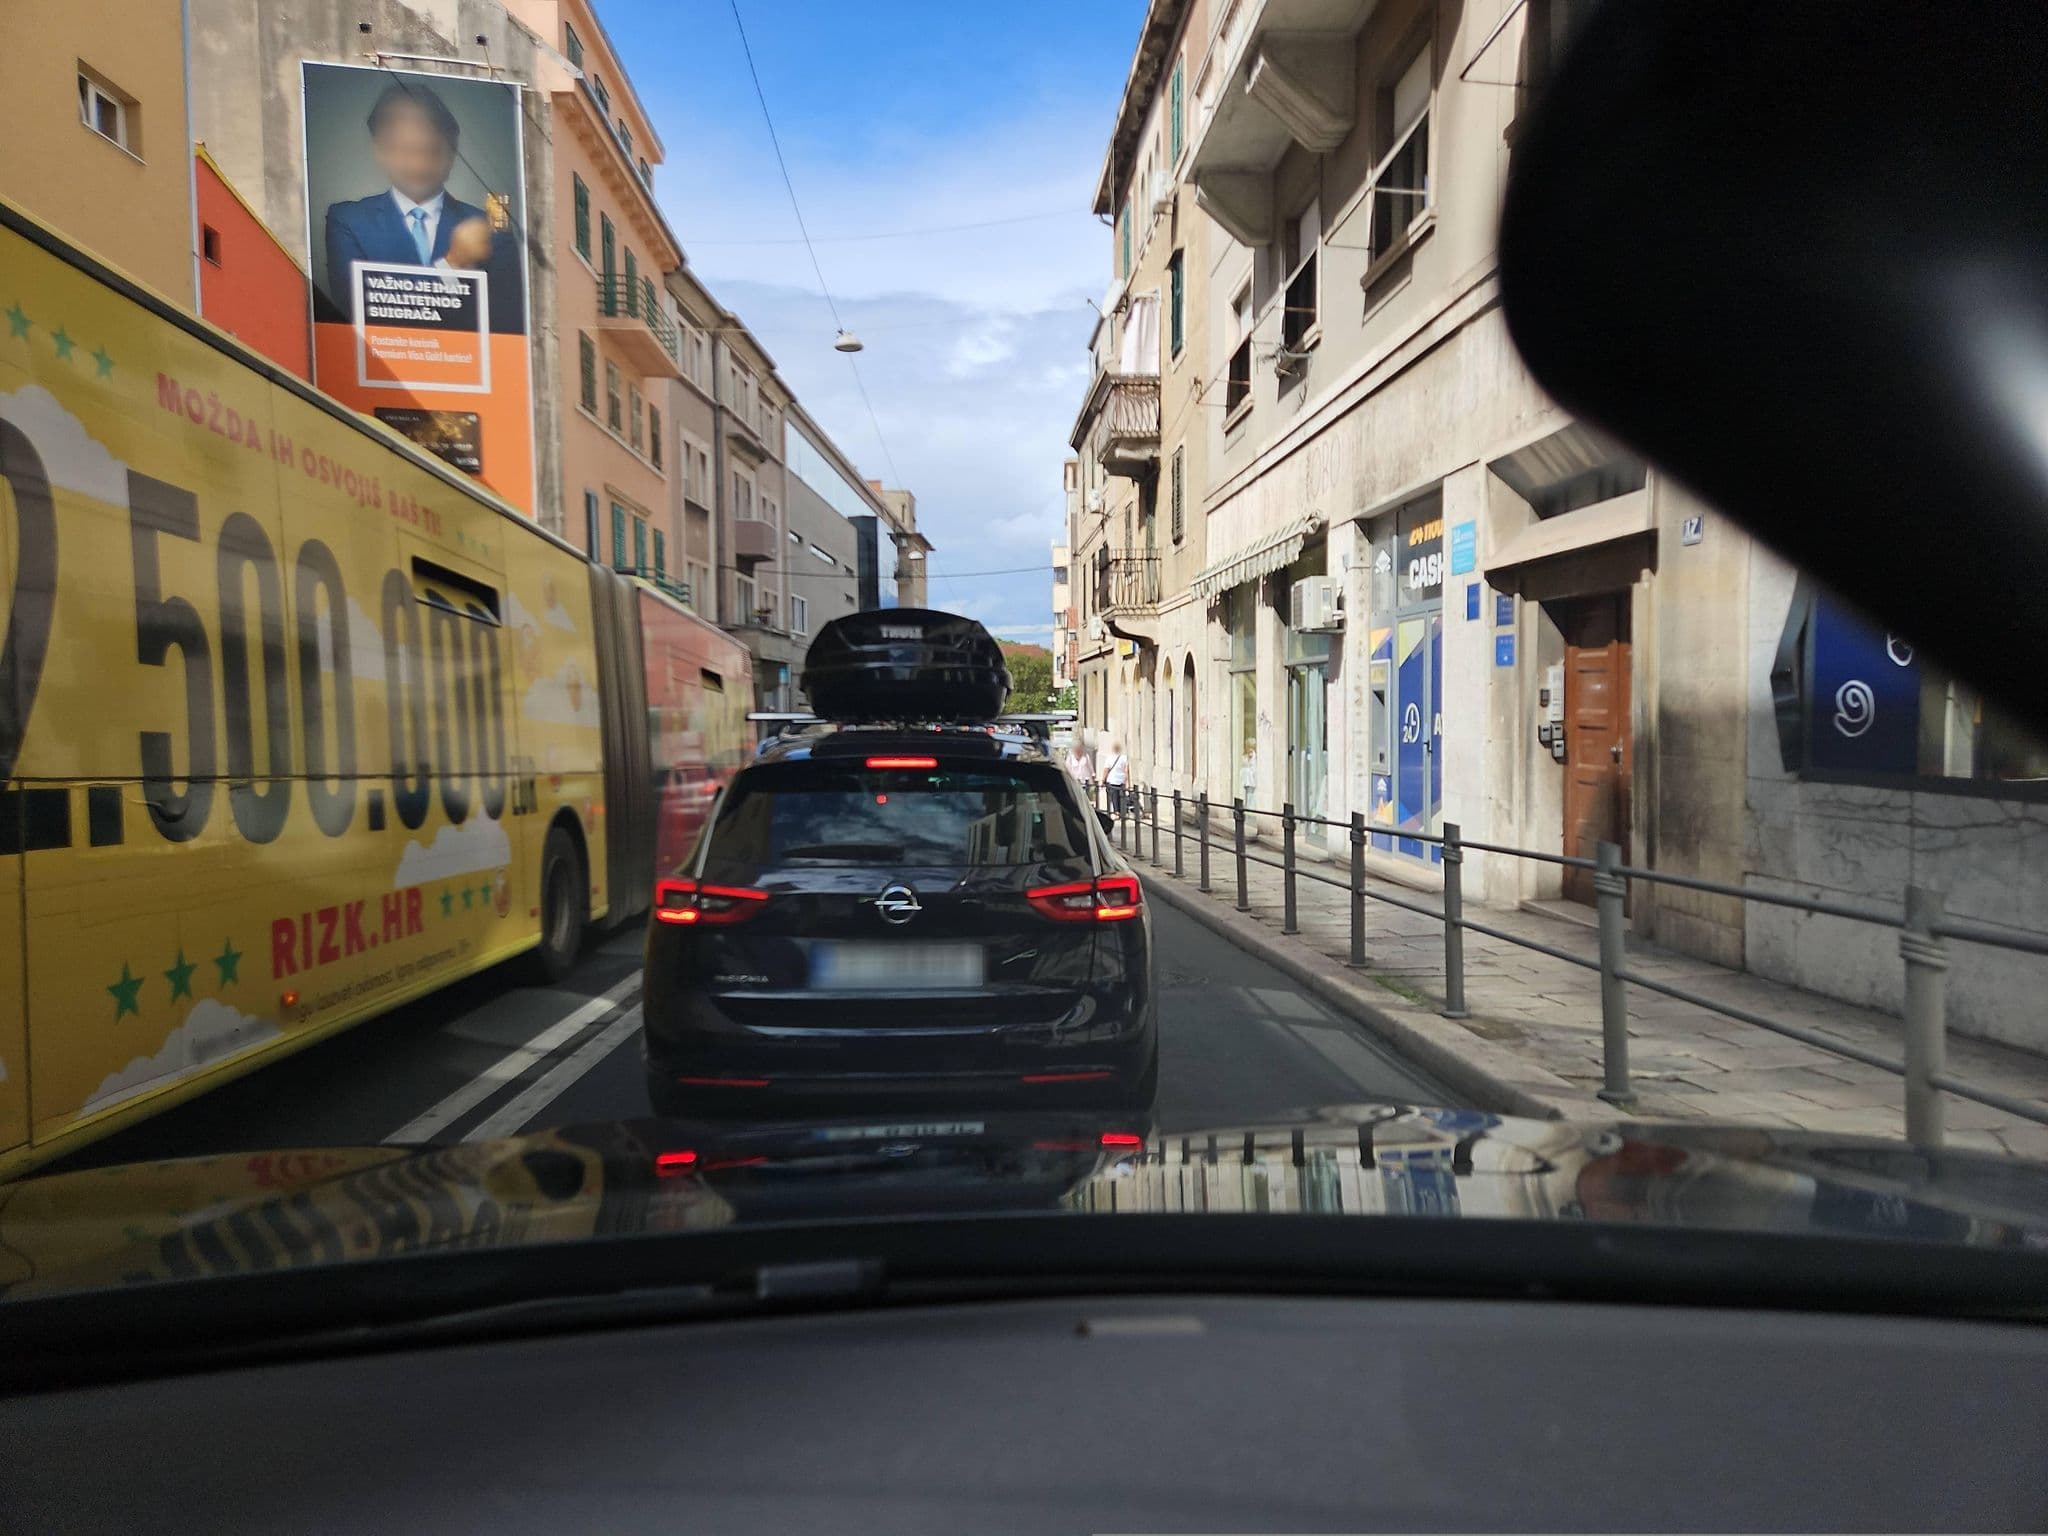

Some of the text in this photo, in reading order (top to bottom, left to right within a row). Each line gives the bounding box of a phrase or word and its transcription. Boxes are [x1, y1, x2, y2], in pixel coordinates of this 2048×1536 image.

[368, 276, 471, 296] VAŽNO JE IMATI
[368, 292, 463, 309] KVALITETNOG
[368, 306, 442, 321] SUIGRAČA
[157, 372, 262, 452] MOŽDA
[270, 429, 294, 468] IH
[302, 447, 382, 509] OSVOJIŠ
[271, 887, 424, 981] RIZK.HR
